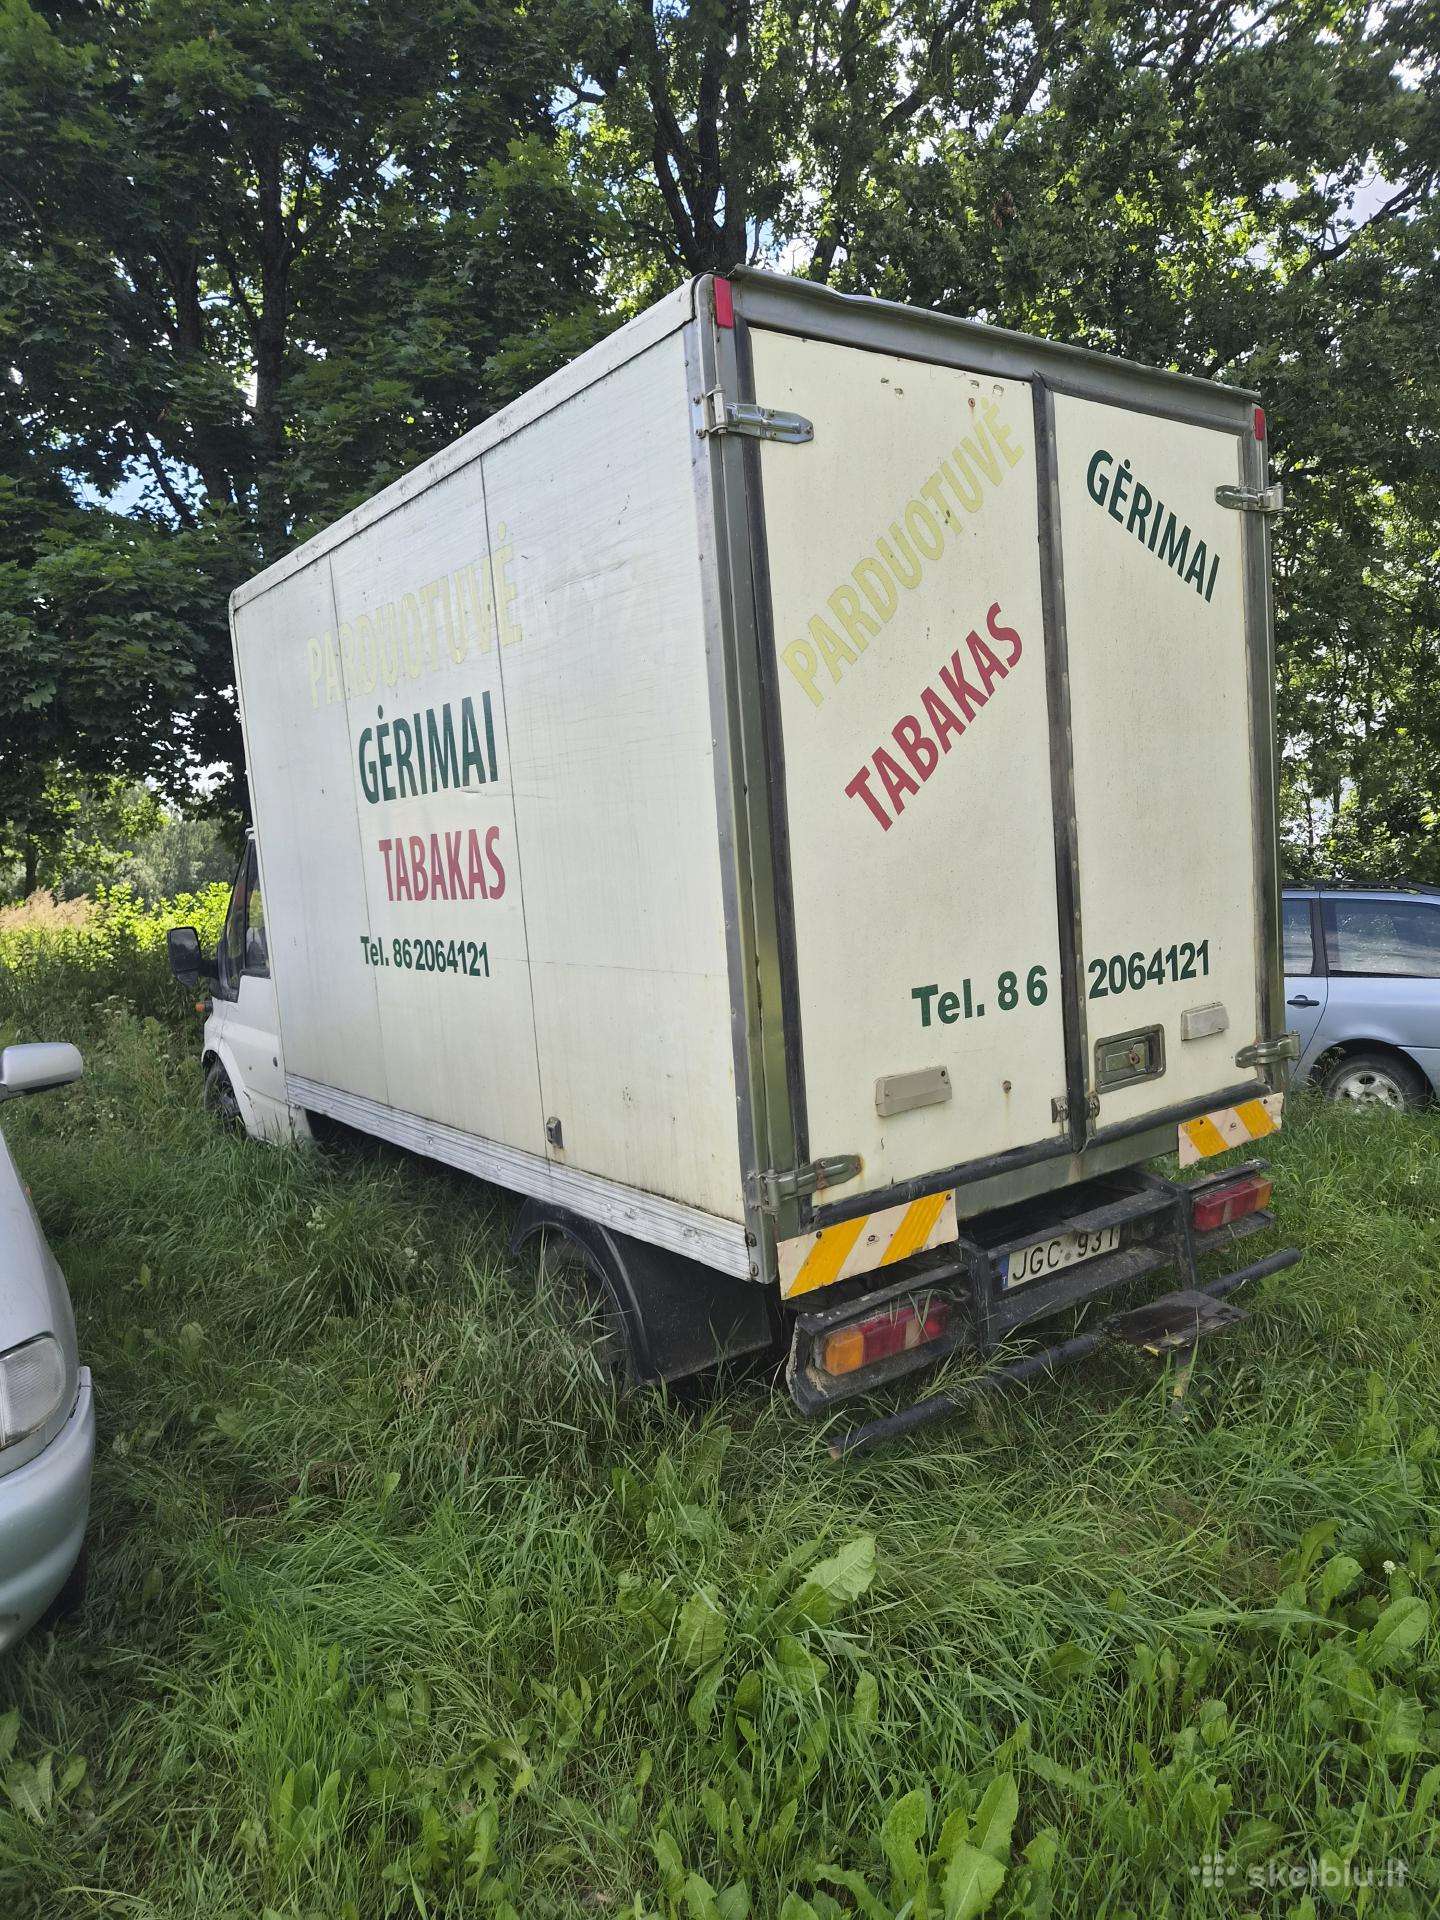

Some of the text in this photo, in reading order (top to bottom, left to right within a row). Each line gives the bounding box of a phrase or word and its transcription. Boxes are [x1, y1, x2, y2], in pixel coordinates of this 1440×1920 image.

[780, 397, 1024, 708] PARDUOTUVĖ
[1087, 449, 1220, 603] GĖRIMAI
[307, 521, 523, 709] PARDUOTUVĖ
[358, 690, 499, 804] GĖRIMAI
[844, 601, 1023, 832] TABAKAS
[378, 825, 506, 901] TABAKAS
[360, 935, 490, 978] Tel. 862064121
[911, 977, 986, 1028] Tel.
[1087, 939, 1209, 1000] 2064121
[1012, 1240, 1062, 1281] JGC
